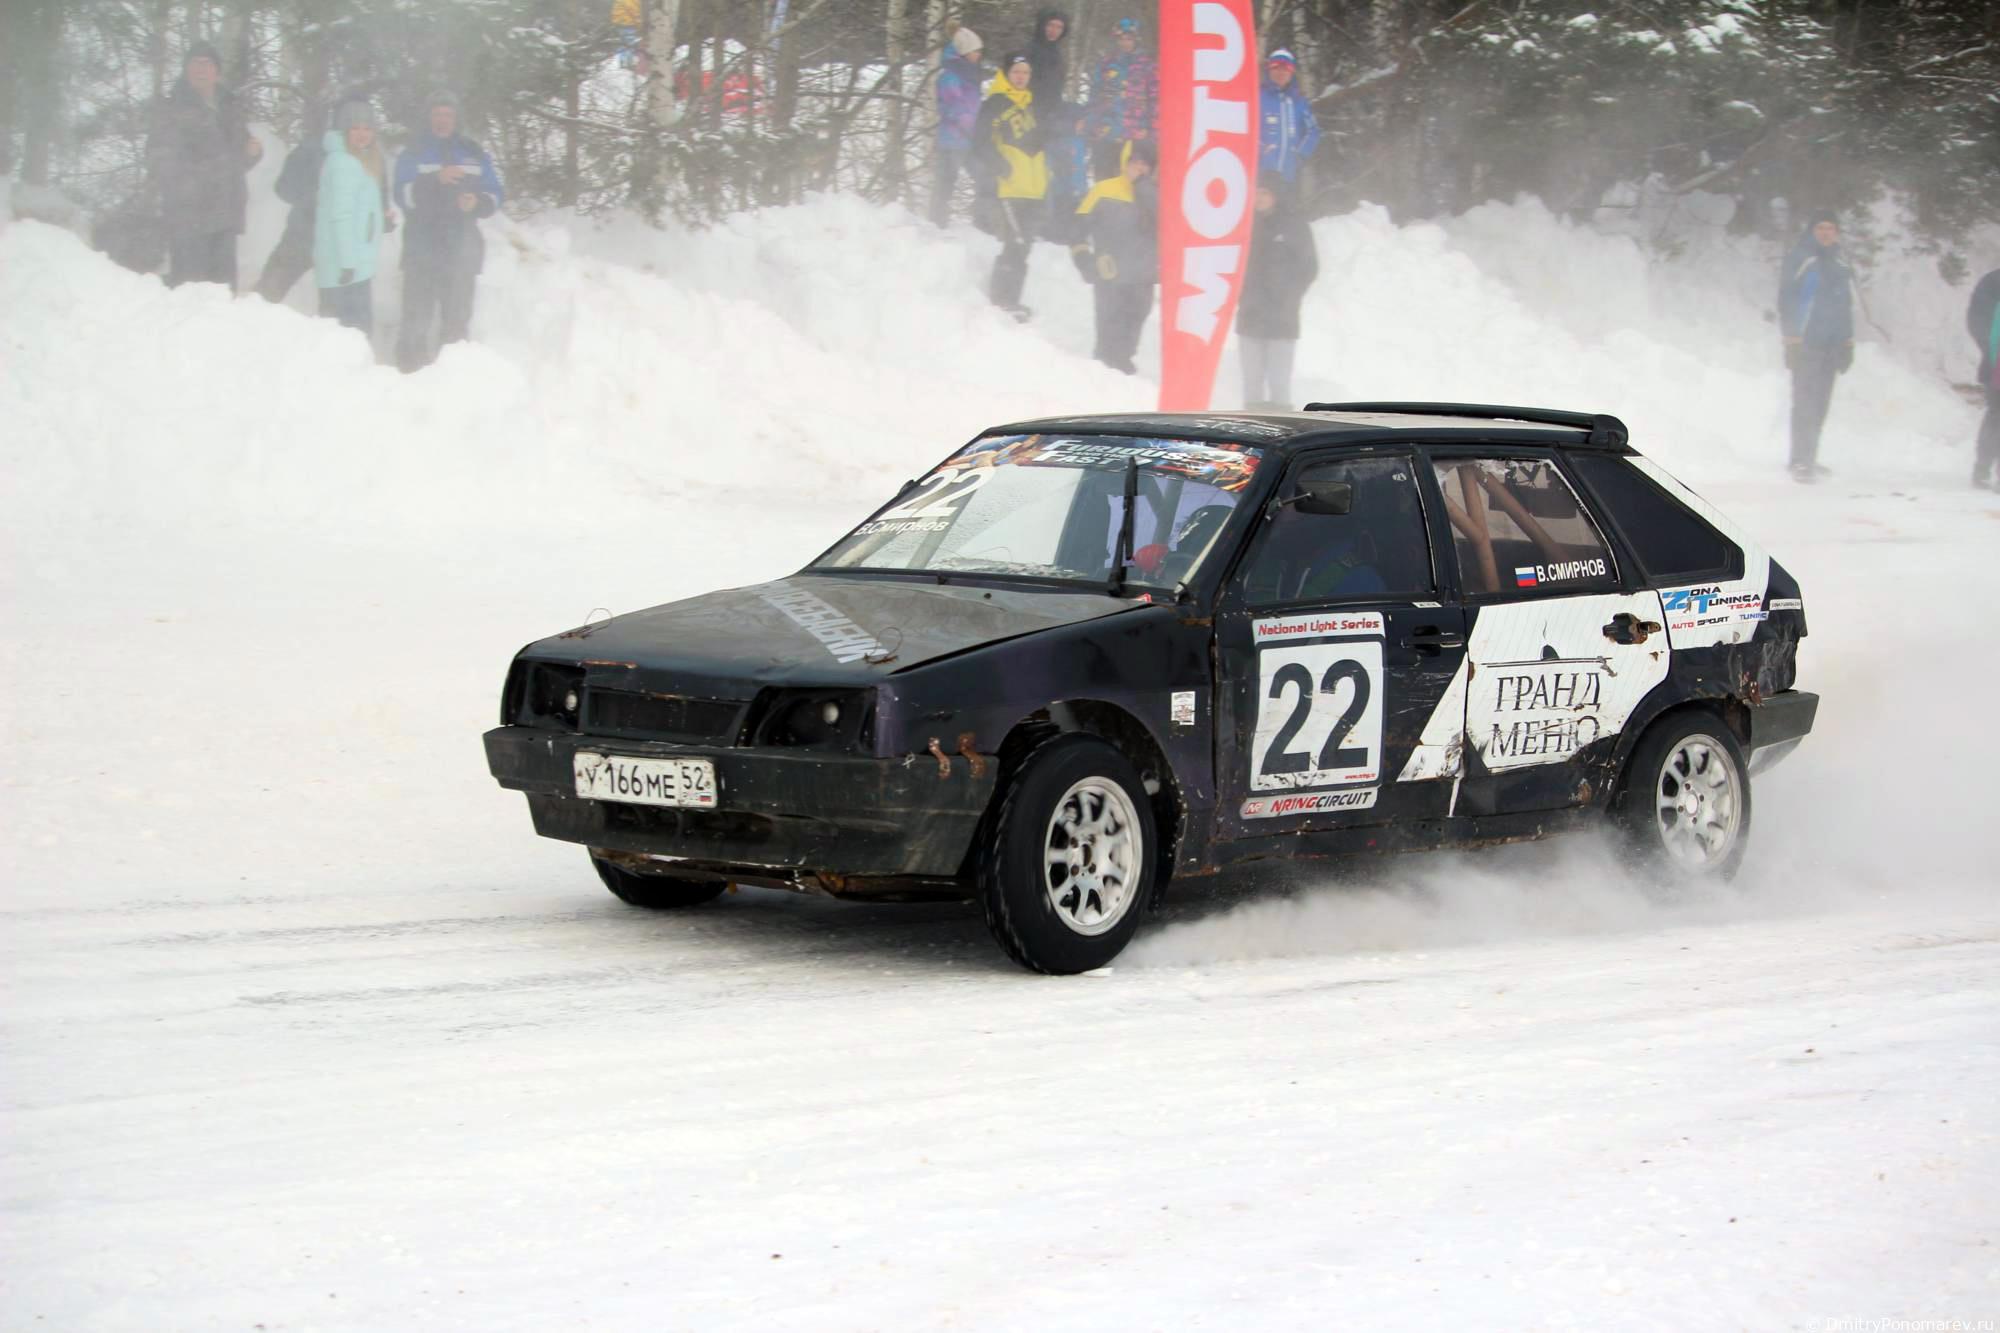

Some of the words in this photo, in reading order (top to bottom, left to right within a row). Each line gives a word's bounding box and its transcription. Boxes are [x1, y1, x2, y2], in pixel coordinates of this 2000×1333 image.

[876, 467, 995, 521] 22
[1535, 559, 1606, 583] В.СМИРНОВ
[1258, 623, 1307, 636] National
[1310, 620, 1338, 633] Light
[1341, 618, 1380, 630] Series
[1671, 621, 1695, 629] AUTO
[1697, 616, 1730, 626] SPORT
[1494, 672, 1601, 713] ГРАНД
[1260, 659, 1371, 775] 22
[1491, 715, 1600, 758] МЕНЮ
[682, 766, 704, 790] 52
[1270, 792, 1372, 813] NRINGCIRCUIT
